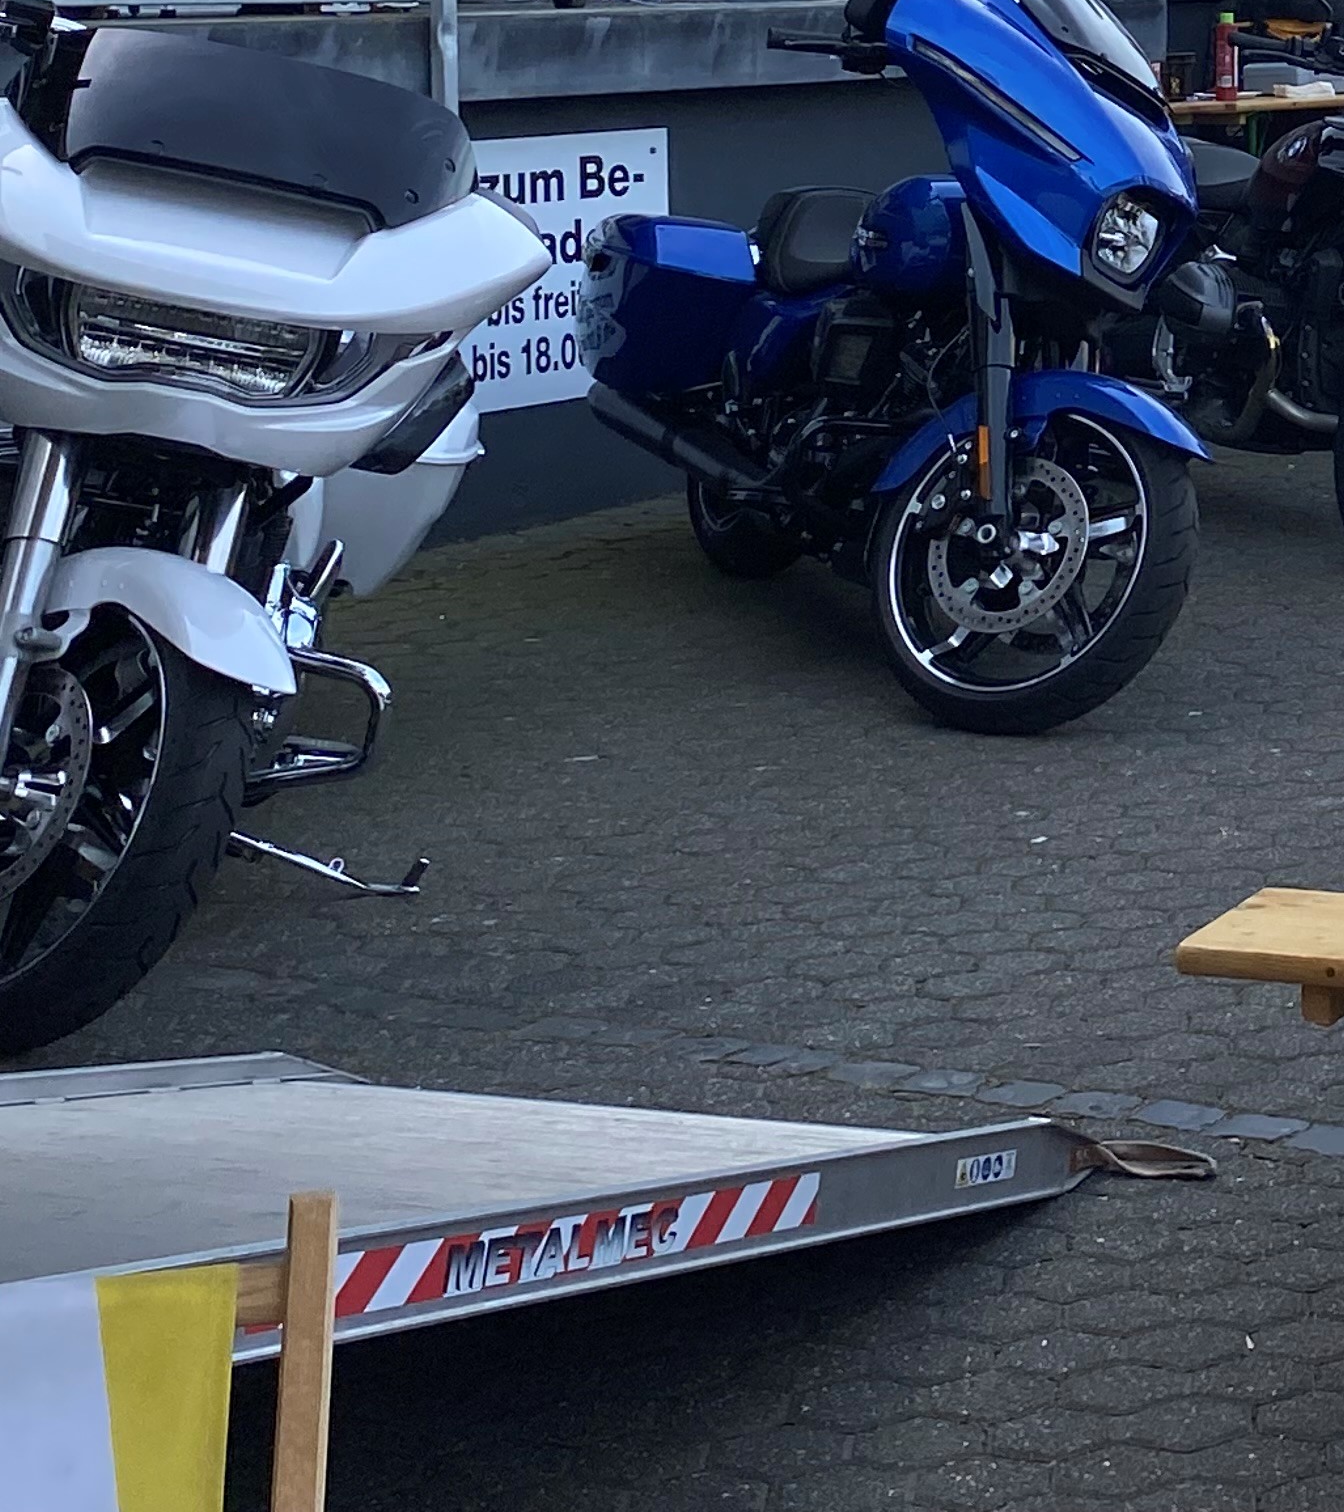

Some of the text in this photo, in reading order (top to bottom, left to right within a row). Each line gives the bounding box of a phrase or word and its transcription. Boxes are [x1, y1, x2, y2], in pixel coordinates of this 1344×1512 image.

[579, 155, 645, 199] Be-
[533, 280, 582, 321] frei
[472, 333, 587, 382] bis 18.0
[443, 1207, 680, 1298] METALMEC
